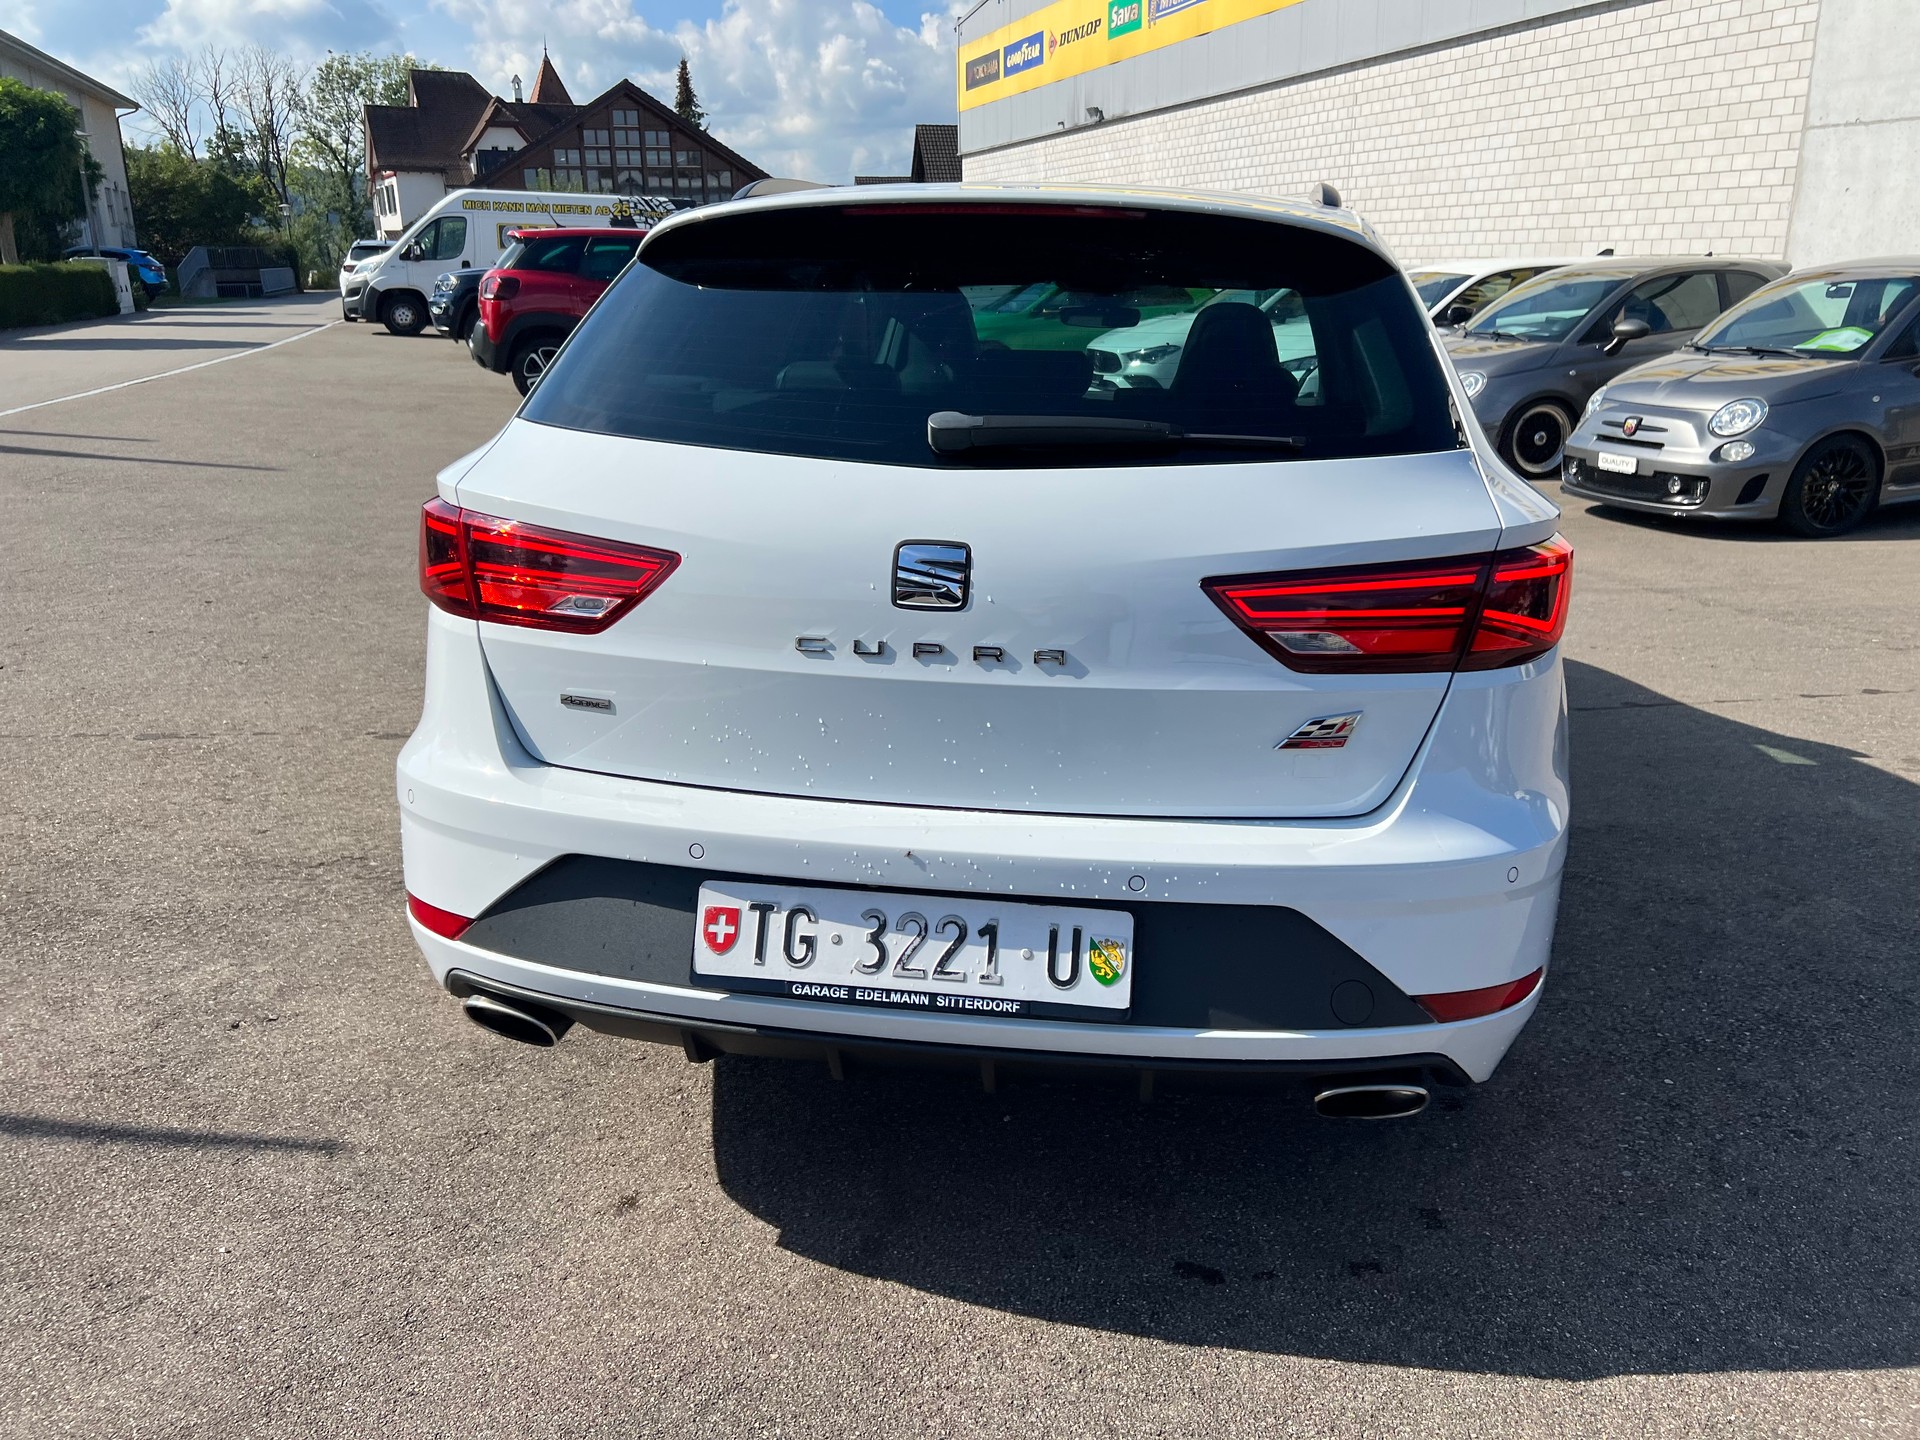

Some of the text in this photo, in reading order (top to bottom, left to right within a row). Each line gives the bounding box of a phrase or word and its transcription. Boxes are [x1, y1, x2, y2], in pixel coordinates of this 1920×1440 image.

[1110, 3, 1139, 29] Sava
[1059, 18, 1101, 47] DUNLOP
[1006, 43, 1040, 68] GOODYEAR
[463, 200, 490, 211] MICH
[493, 201, 524, 212] KANN
[526, 203, 550, 213] MAN
[553, 204, 592, 215] MIETEN
[594, 206, 610, 216] AB
[1601, 456, 1630, 468] QUALITY
[795, 636, 1067, 667] CUPRA
[748, 901, 1084, 991] TG 3221 U
[792, 983, 1021, 1013] GARAGE EDELMANN SITTERDORF
